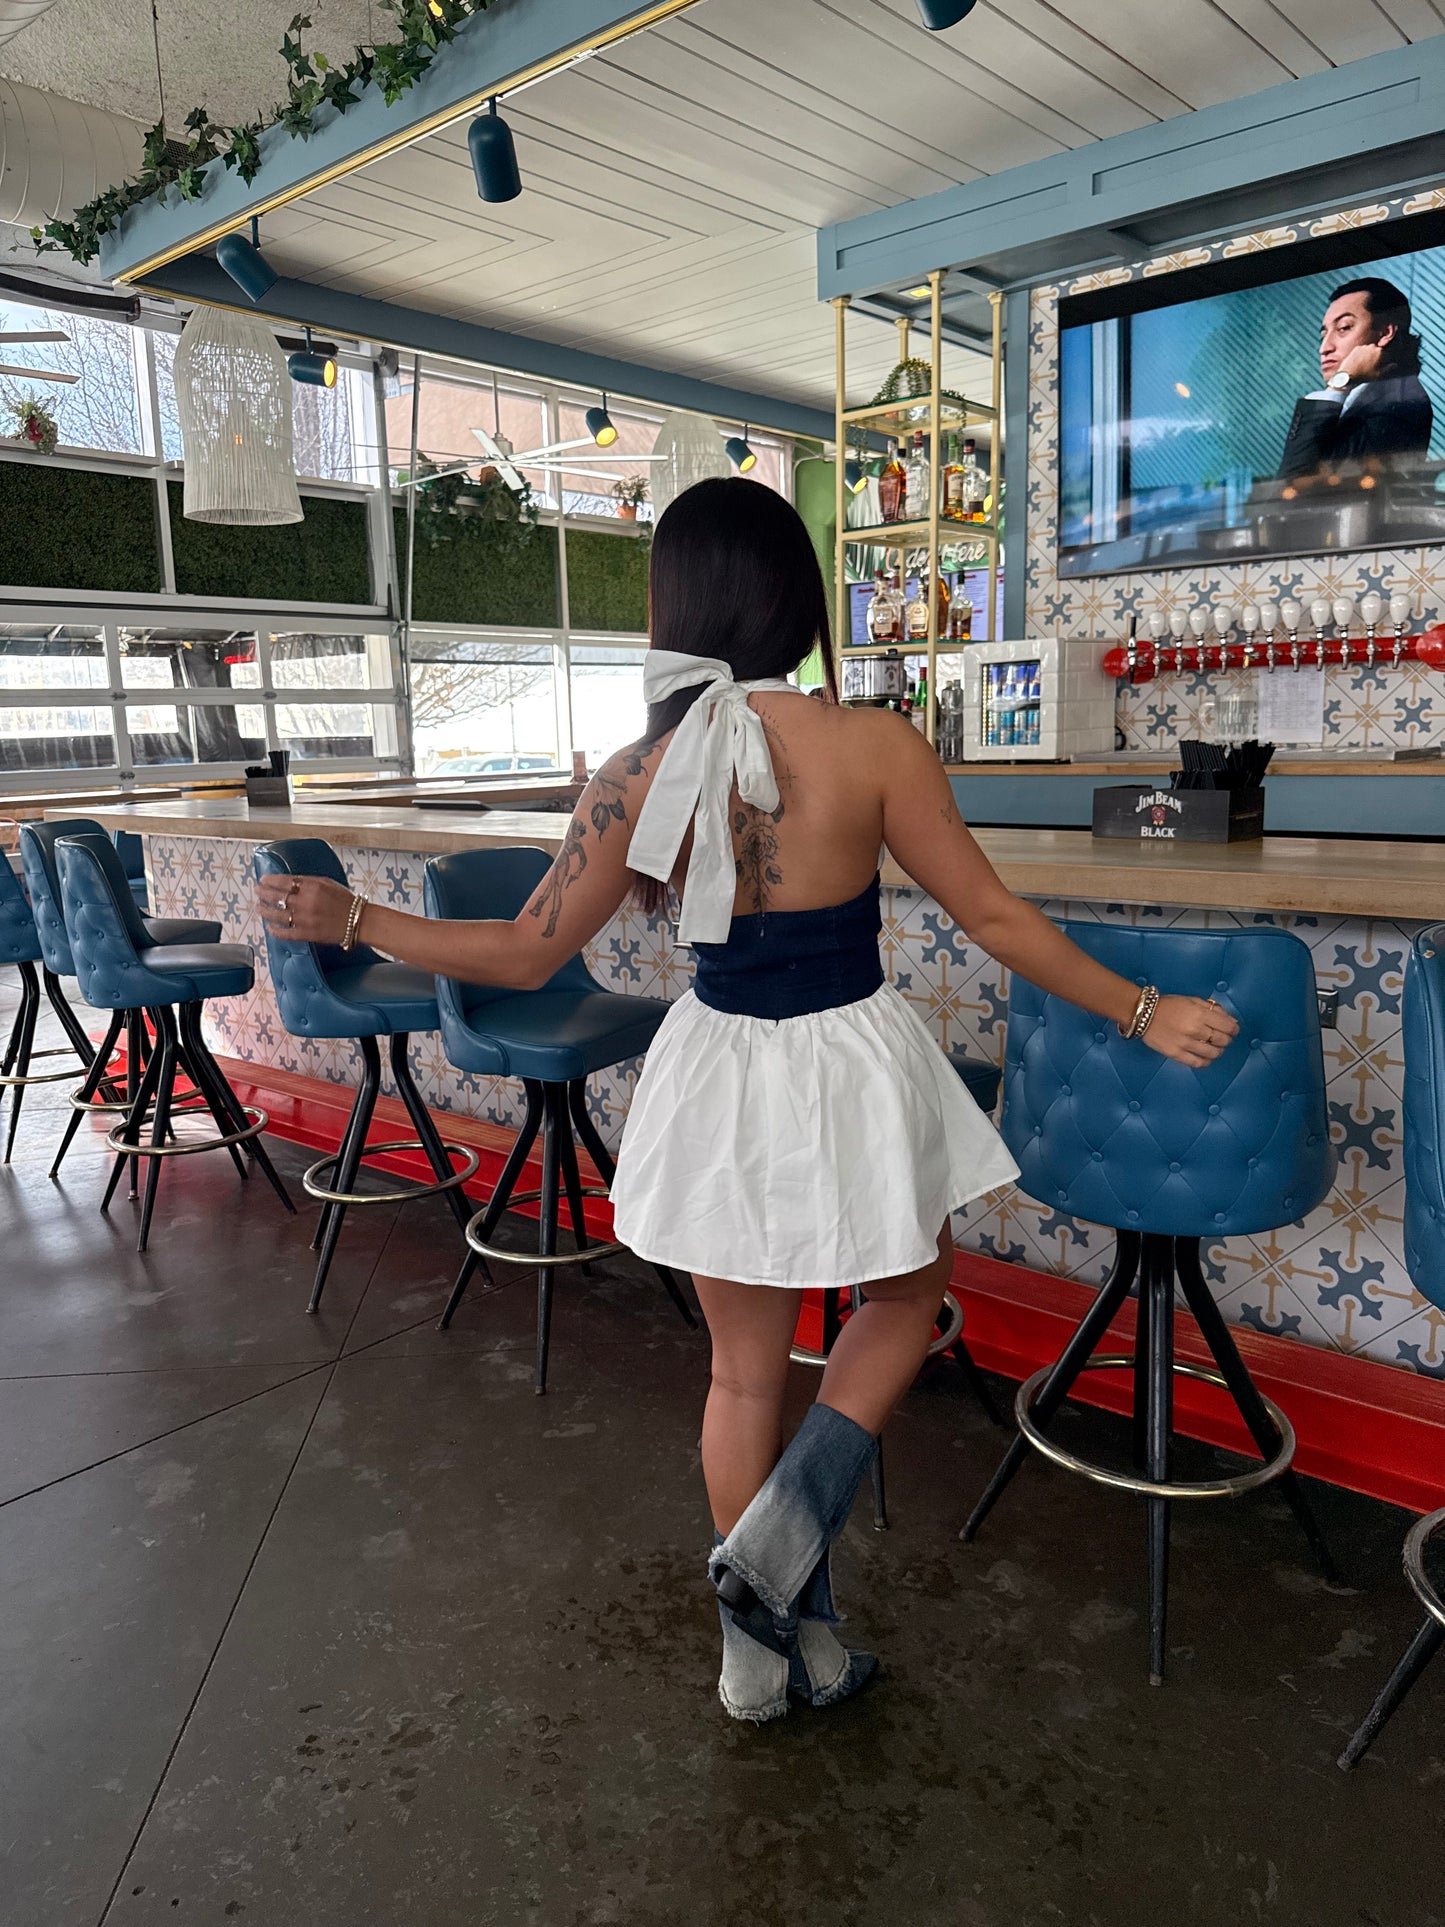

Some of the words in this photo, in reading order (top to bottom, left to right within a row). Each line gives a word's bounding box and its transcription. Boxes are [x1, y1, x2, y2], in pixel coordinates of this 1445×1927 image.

[1135, 794, 1155, 813] JIM
[1155, 791, 1182, 814] BEAM
[1140, 825, 1175, 838] BLACK
